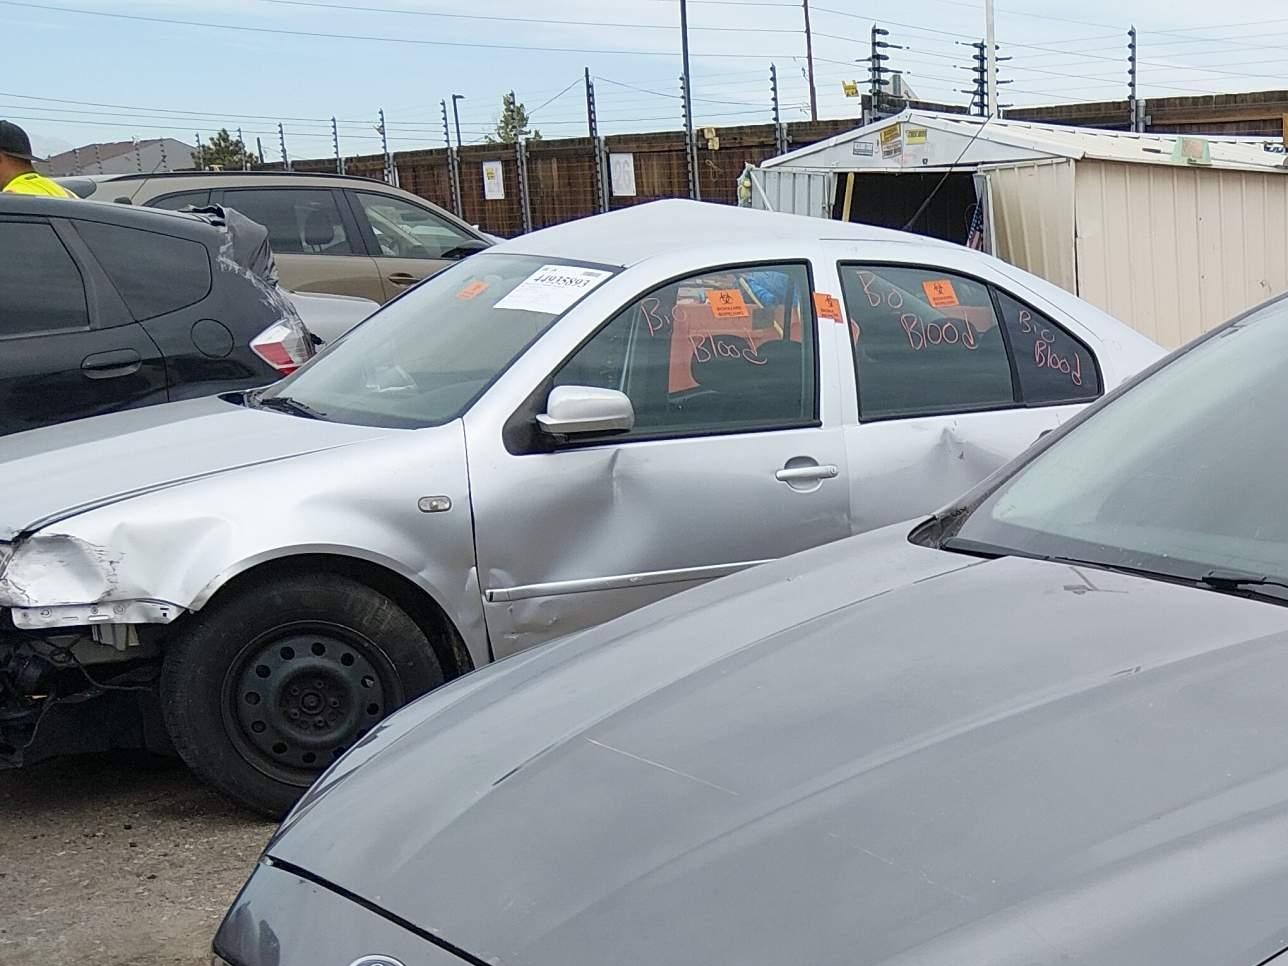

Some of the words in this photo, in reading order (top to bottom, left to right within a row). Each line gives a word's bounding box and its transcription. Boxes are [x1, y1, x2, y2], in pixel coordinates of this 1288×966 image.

[688, 328, 768, 365] Blood
[900, 311, 979, 351] Blood
[1034, 340, 1082, 386] Blood
